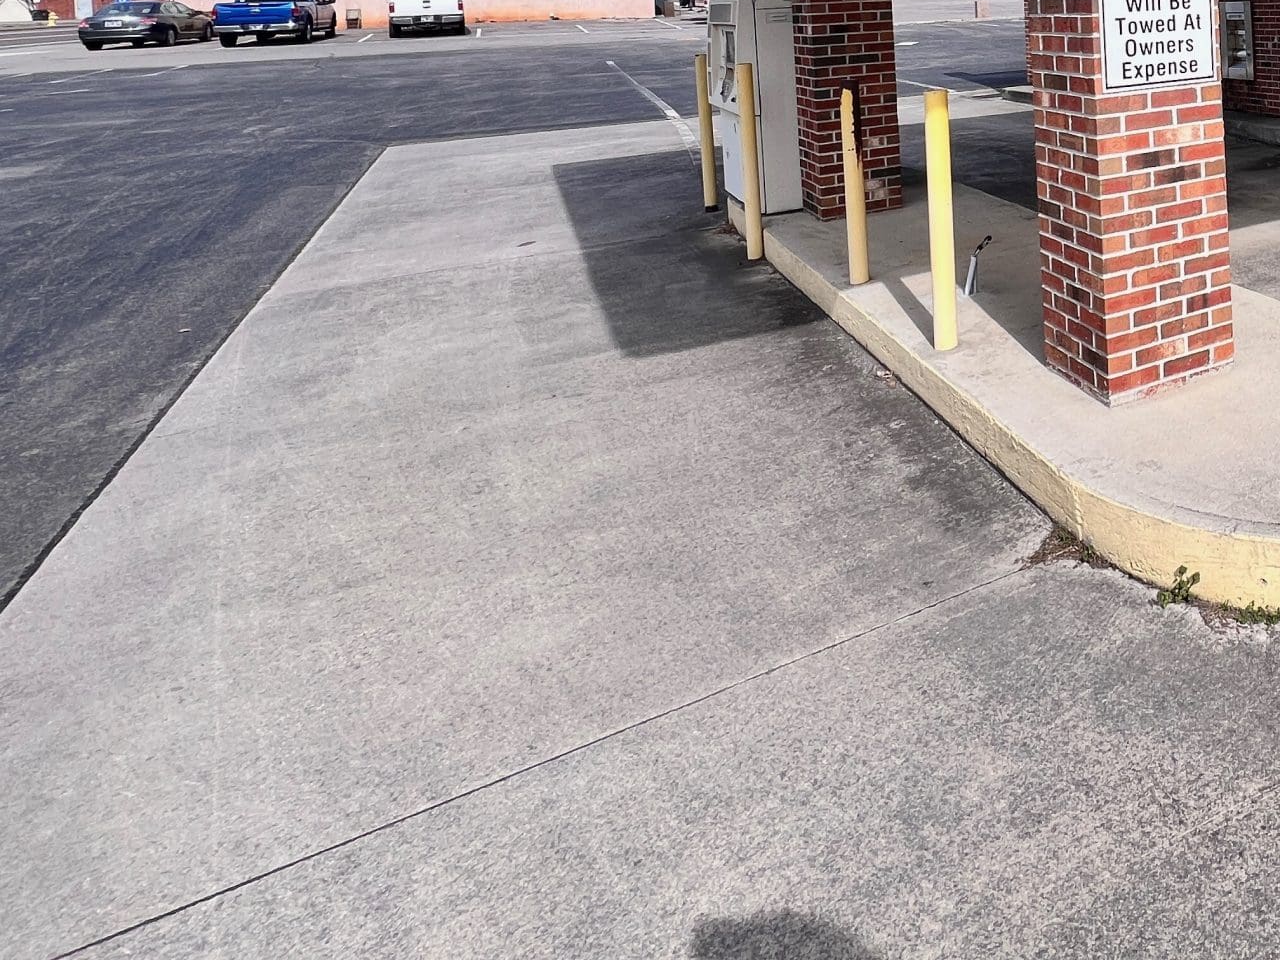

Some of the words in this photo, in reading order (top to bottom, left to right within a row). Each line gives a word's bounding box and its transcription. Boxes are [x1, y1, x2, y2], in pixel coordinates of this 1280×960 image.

[1115, 15, 1176, 35] Towed
[1184, 14, 1202, 30] At
[1125, 38, 1194, 57] Owners
[1122, 59, 1198, 81] Expense
